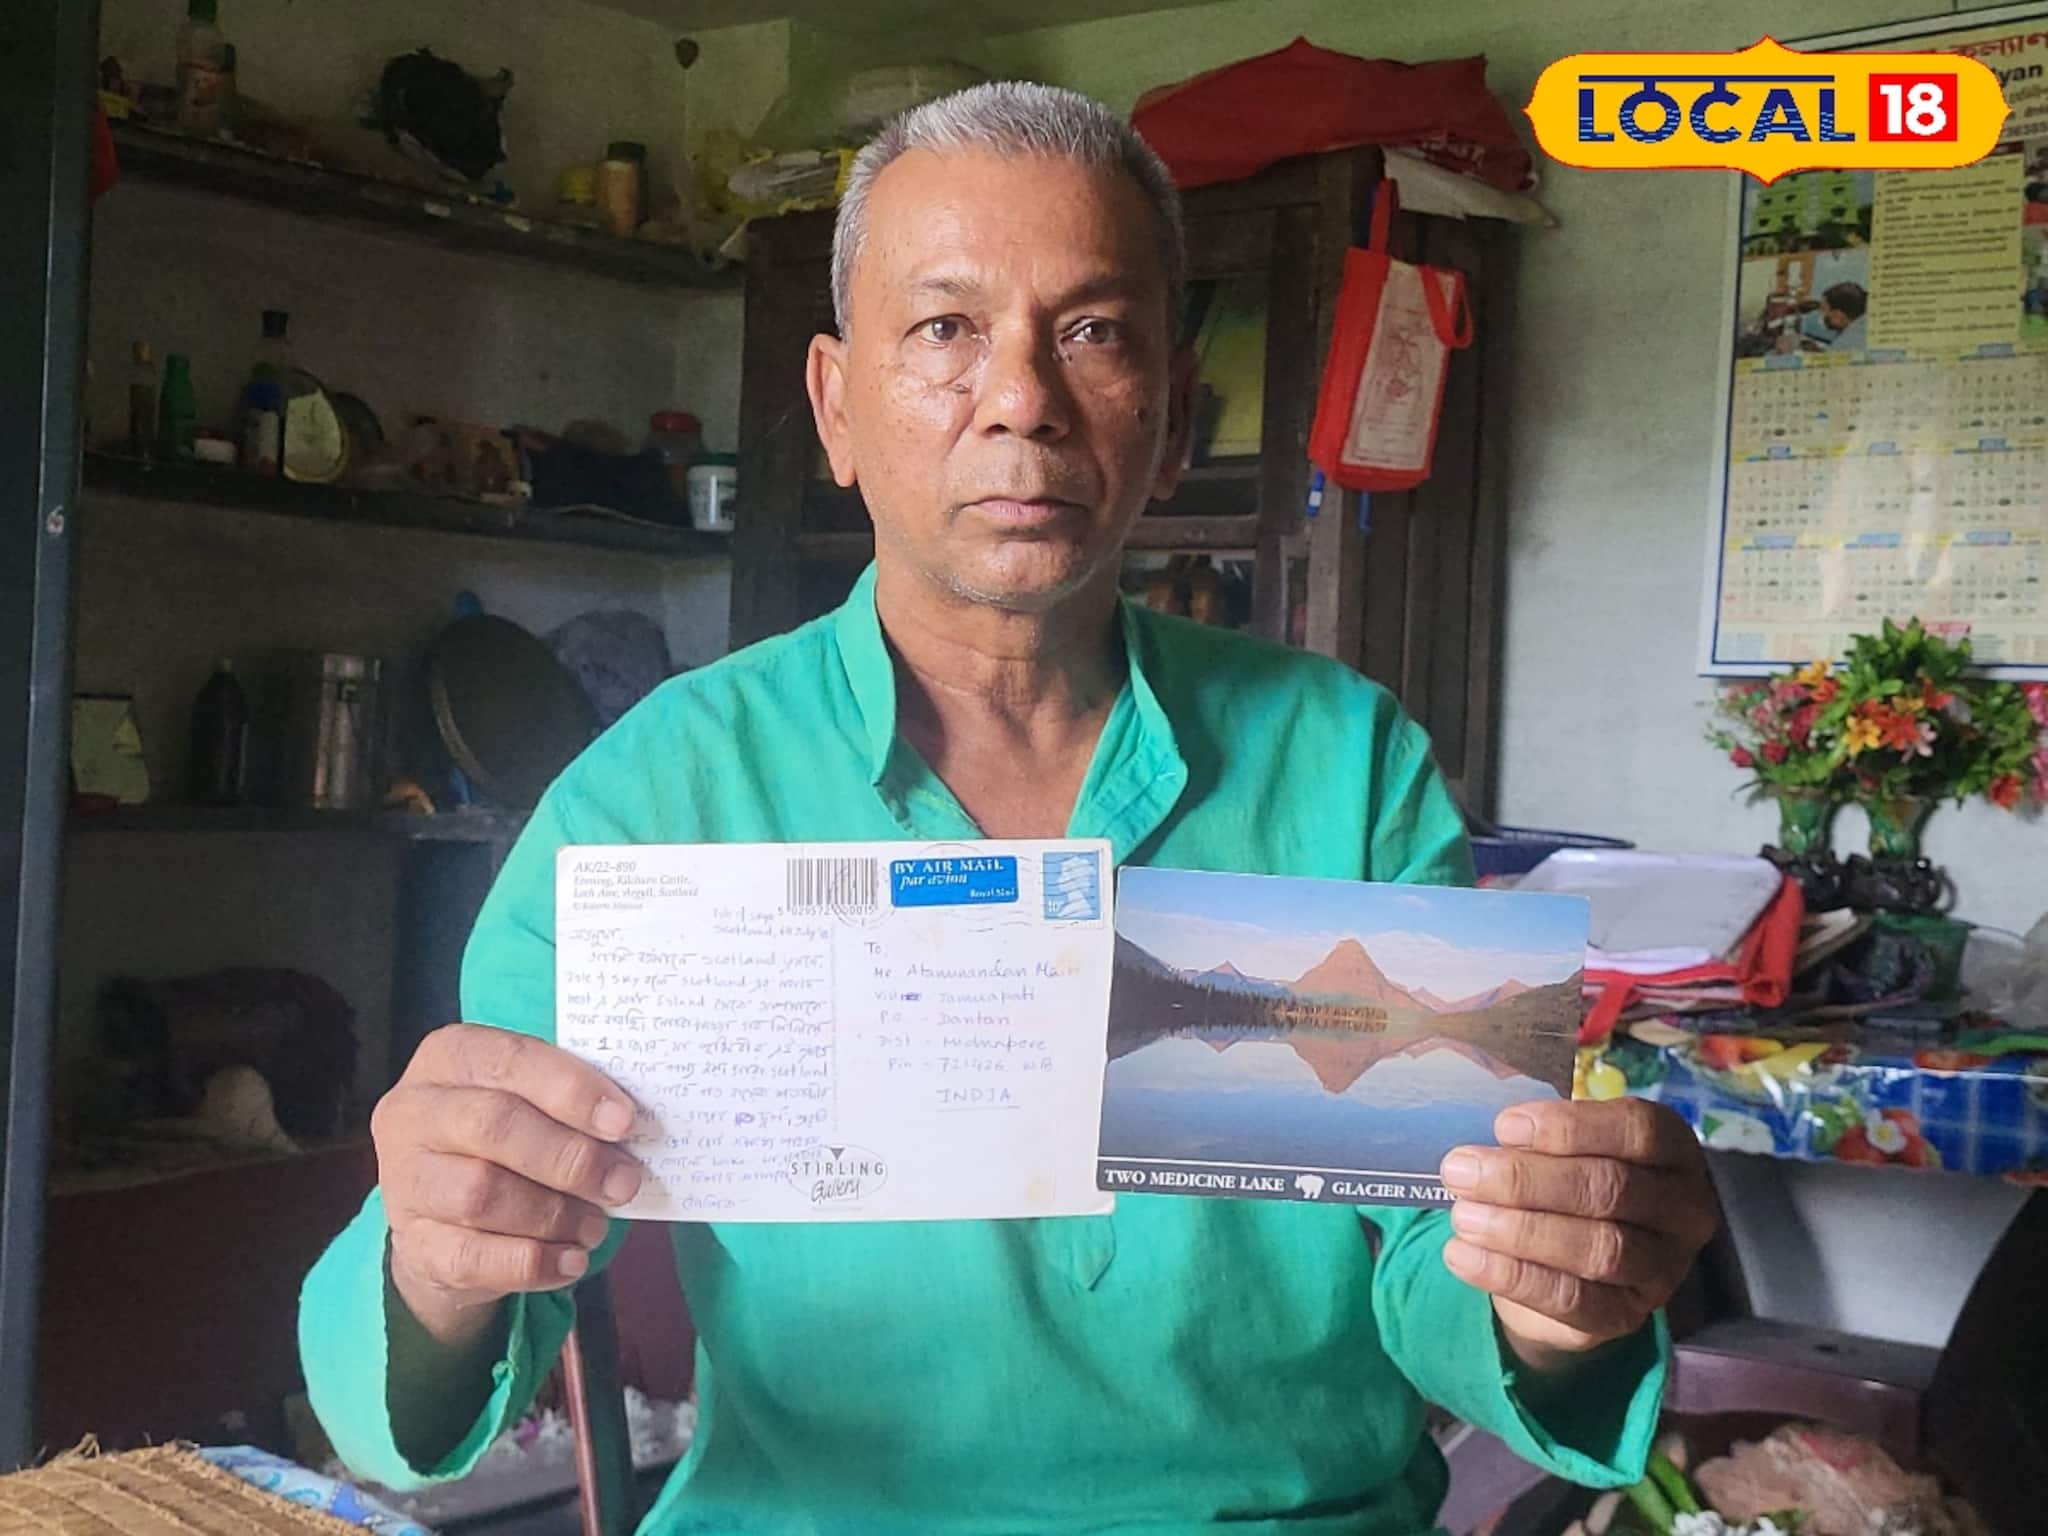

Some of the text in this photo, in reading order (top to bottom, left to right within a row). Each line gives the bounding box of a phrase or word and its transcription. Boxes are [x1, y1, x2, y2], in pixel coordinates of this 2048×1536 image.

[1990, 63, 2043, 89] yan
[895, 858, 1004, 874] BY AIR MAIL
[899, 873, 968, 890] par avion
[791, 1161, 884, 1176] STIRLING
[1104, 1168, 1146, 1184] TWO
[1150, 1170, 1237, 1190] MEDICINE
[1240, 1175, 1286, 1193] LAKE
[1332, 1180, 1407, 1200] GLACIER
